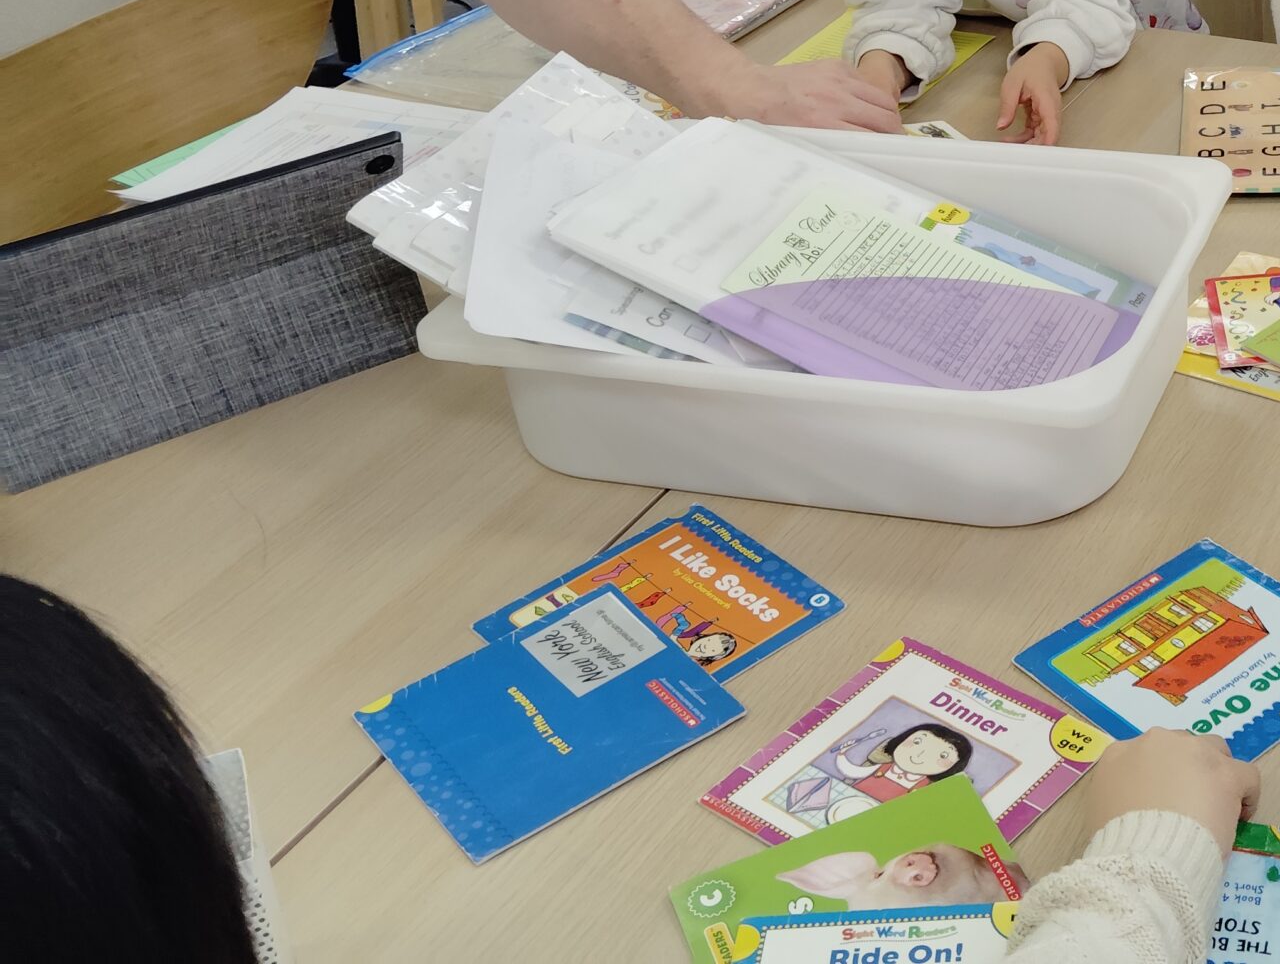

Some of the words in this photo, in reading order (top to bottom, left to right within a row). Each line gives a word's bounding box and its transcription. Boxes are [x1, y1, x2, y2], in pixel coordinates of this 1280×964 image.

[1201, 80, 1226, 93] E
[1200, 103, 1226, 116] D
[1200, 126, 1226, 138] C
[1198, 148, 1225, 158] B
[942, 206, 962, 224] funny
[749, 251, 801, 286] Library
[799, 204, 837, 233] Card
[800, 246, 824, 264] Aoi
[646, 307, 675, 328] Can
[658, 535, 683, 550] I
[691, 511, 715, 528] First
[711, 523, 732, 542] Little
[729, 539, 763, 564] Readers
[669, 543, 717, 578] Like
[714, 574, 781, 624] Socks
[813, 595, 826, 605] B
[1081, 579, 1152, 627] SCHOLASTIC
[561, 619, 598, 647] School
[537, 628, 580, 661] York
[591, 642, 627, 672] English
[1247, 656, 1266, 674] Liza
[1262, 650, 1276, 662] by
[571, 656, 610, 684] New
[1200, 665, 1251, 706] Charlesworth
[507, 686, 539, 719] Readers
[648, 681, 691, 723] SCHOLASTIC
[948, 676, 973, 694] Sight
[971, 687, 993, 705] Word
[990, 699, 1028, 720] Readers
[929, 691, 1009, 737] Dinner
[1187, 693, 1252, 735] Ove
[532, 713, 554, 738] Little
[1071, 727, 1093, 744] we
[547, 735, 573, 756] First
[1057, 738, 1086, 754] get
[708, 797, 764, 833] SCHOLASTIC
[982, 843, 1022, 901] CHOLASTIC
[1221, 892, 1229, 904] 4
[1234, 881, 1265, 895] Short
[1234, 893, 1263, 906] Book
[842, 927, 875, 943] Sight
[875, 926, 906, 940] Word
[907, 924, 957, 940] Readers
[829, 948, 902, 964] Ride
[907, 943, 964, 964] On!
[1236, 938, 1273, 956] THE
